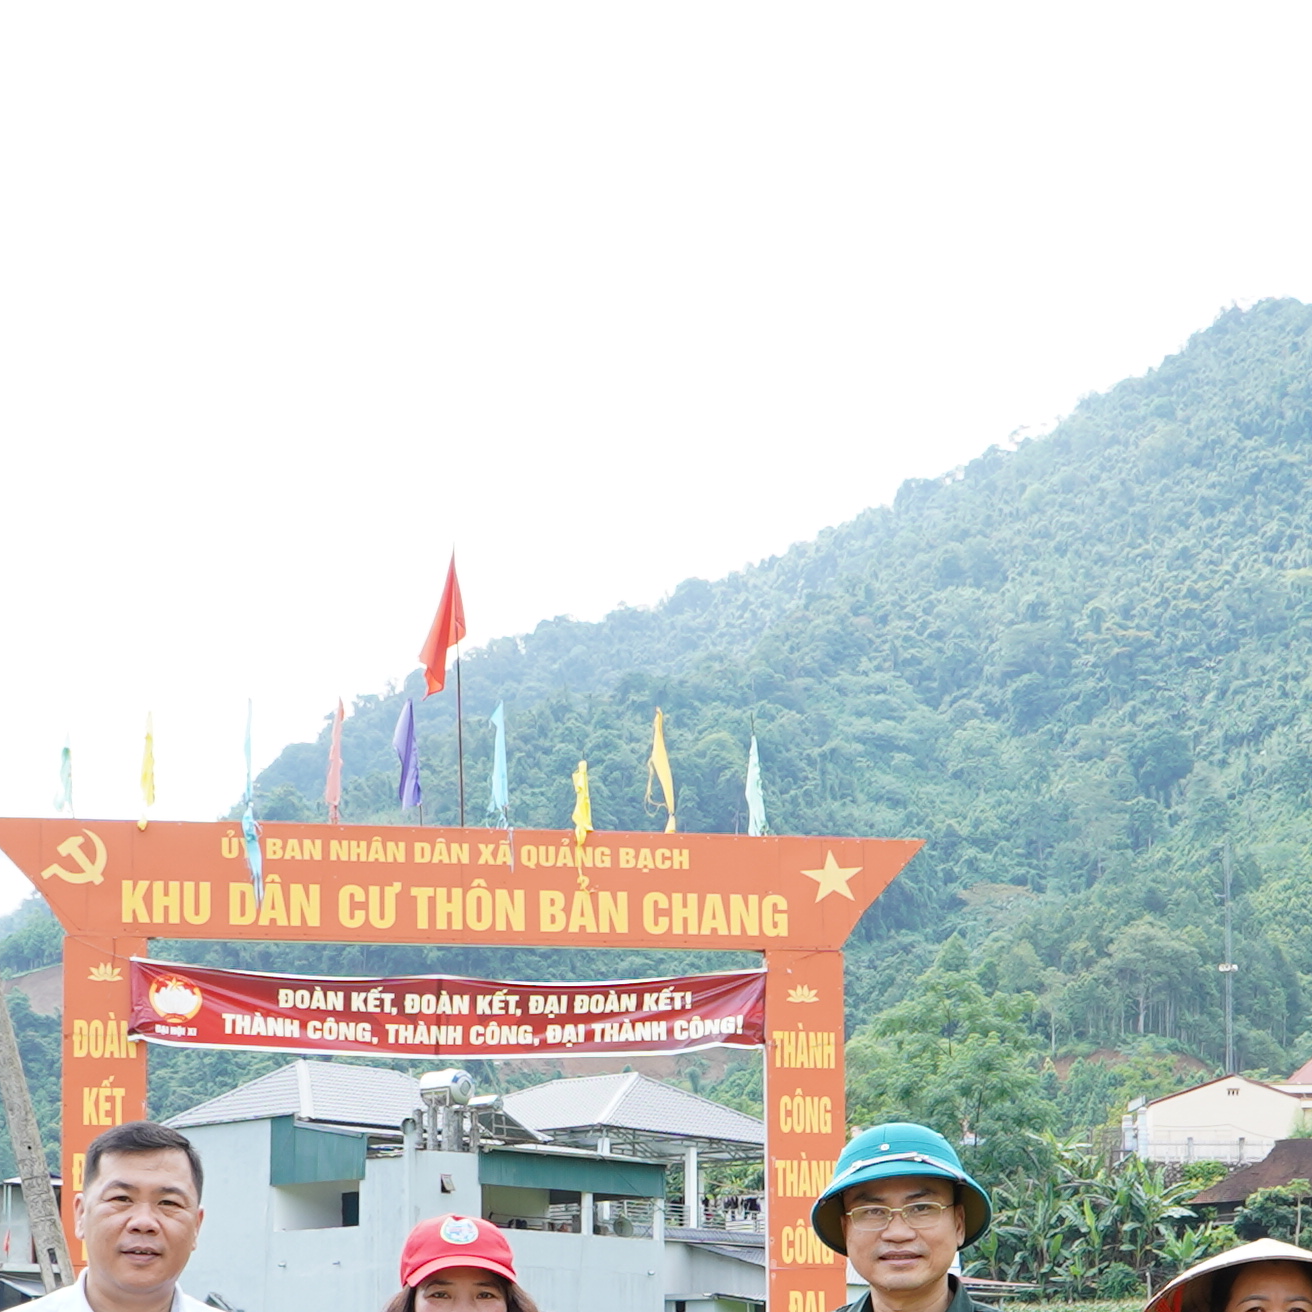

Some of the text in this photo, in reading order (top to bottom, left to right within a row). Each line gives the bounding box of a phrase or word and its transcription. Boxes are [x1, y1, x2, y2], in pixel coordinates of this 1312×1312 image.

[266, 838, 323, 861] BAN
[330, 836, 406, 863] NHÂN
[414, 838, 470, 864] DÂN
[477, 840, 513, 866] XÃ
[521, 837, 612, 869] QUẢNG
[620, 847, 690, 873] BẠCH
[121, 873, 789, 938] KHU DÂN CƯ THÔN BẢN CHANG
[278, 986, 692, 1019] ĐOÀN KẾT, ĐOÀN KẾT, ĐẠI ĐOÀN KẾT!
[72, 1012, 137, 1059] ĐOÀN
[222, 1012, 744, 1048] THÀNH CÔNG, THÀNH CÔNG, ĐẠI THÀNH CÔNG!
[773, 1023, 836, 1069] THÀNH
[82, 1075, 126, 1126] KẾT
[779, 1088, 833, 1134] CÔNG
